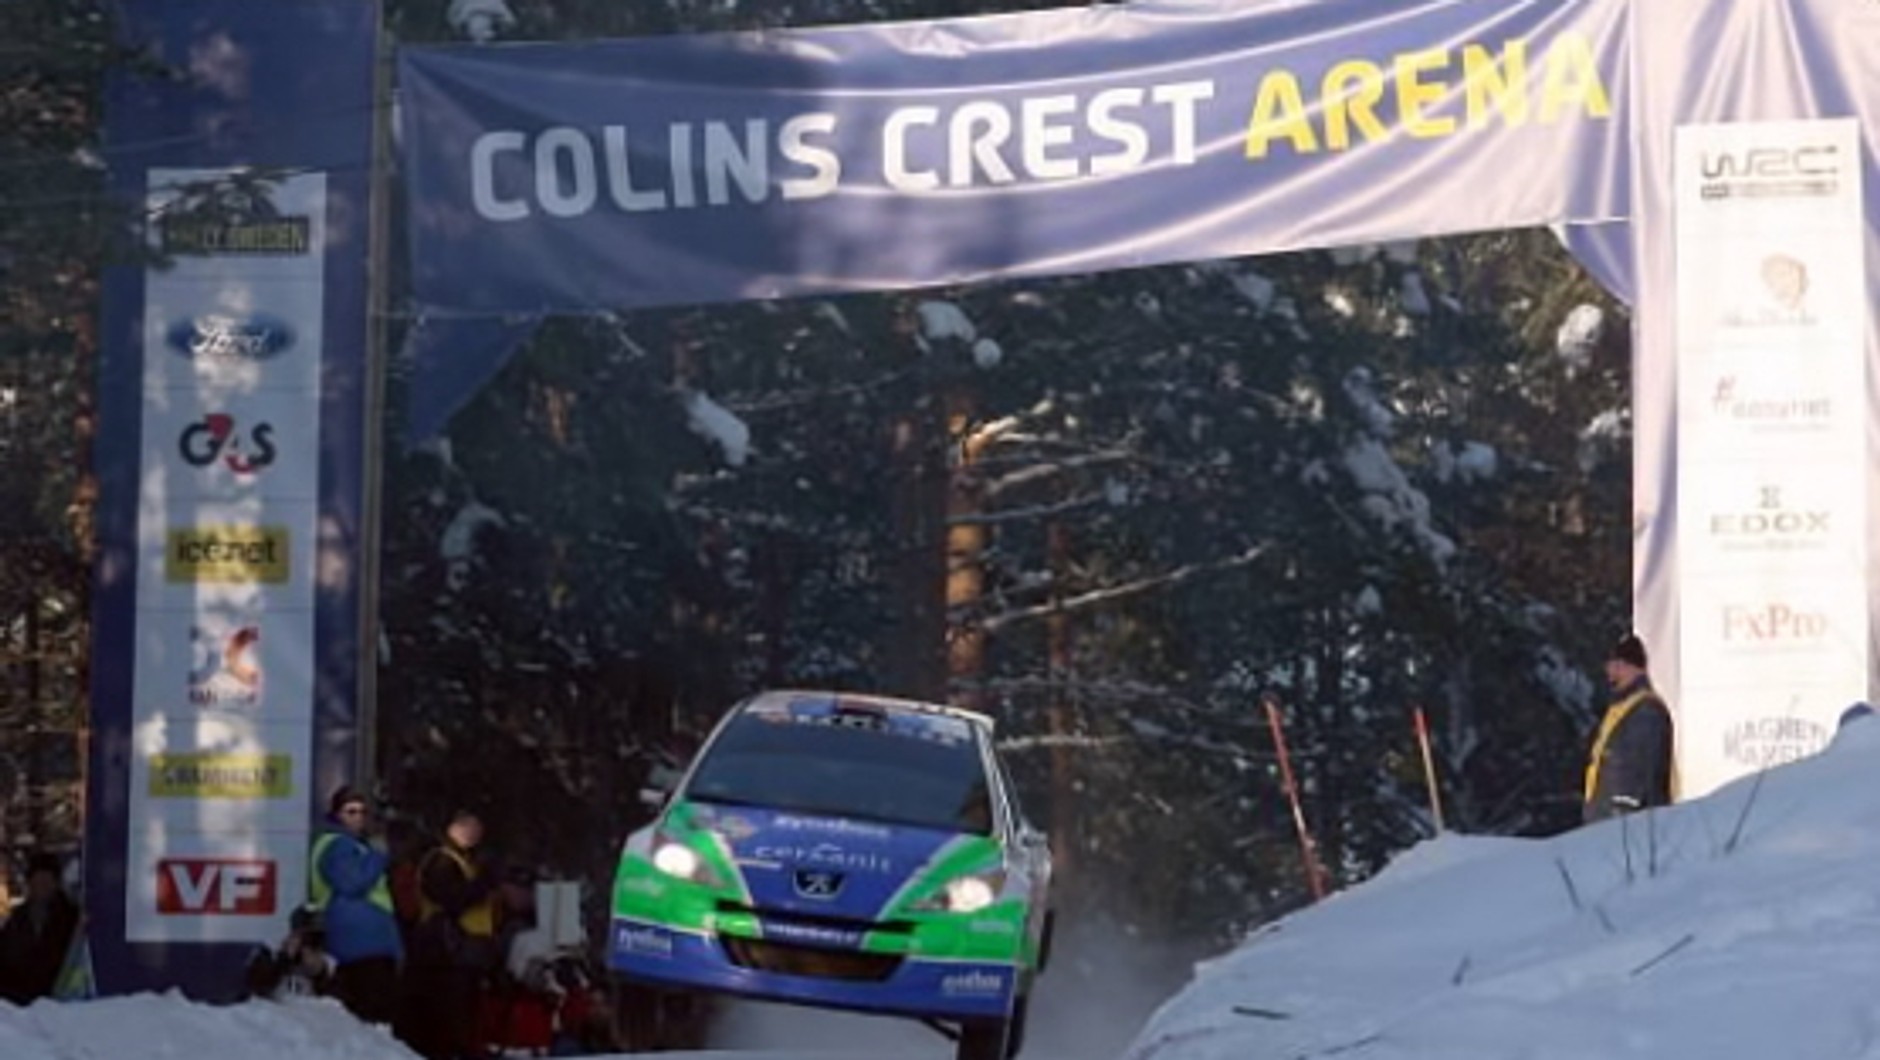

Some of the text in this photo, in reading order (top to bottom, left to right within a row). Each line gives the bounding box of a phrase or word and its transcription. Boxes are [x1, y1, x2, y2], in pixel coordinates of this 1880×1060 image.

[470, 31, 1611, 222] COLINS CREST ARENA
[1700, 145, 1838, 178] WRC
[178, 413, 276, 475] G4S
[1709, 510, 1831, 535] EDOX
[1722, 602, 1829, 641] FxPro
[168, 863, 266, 909] VF
